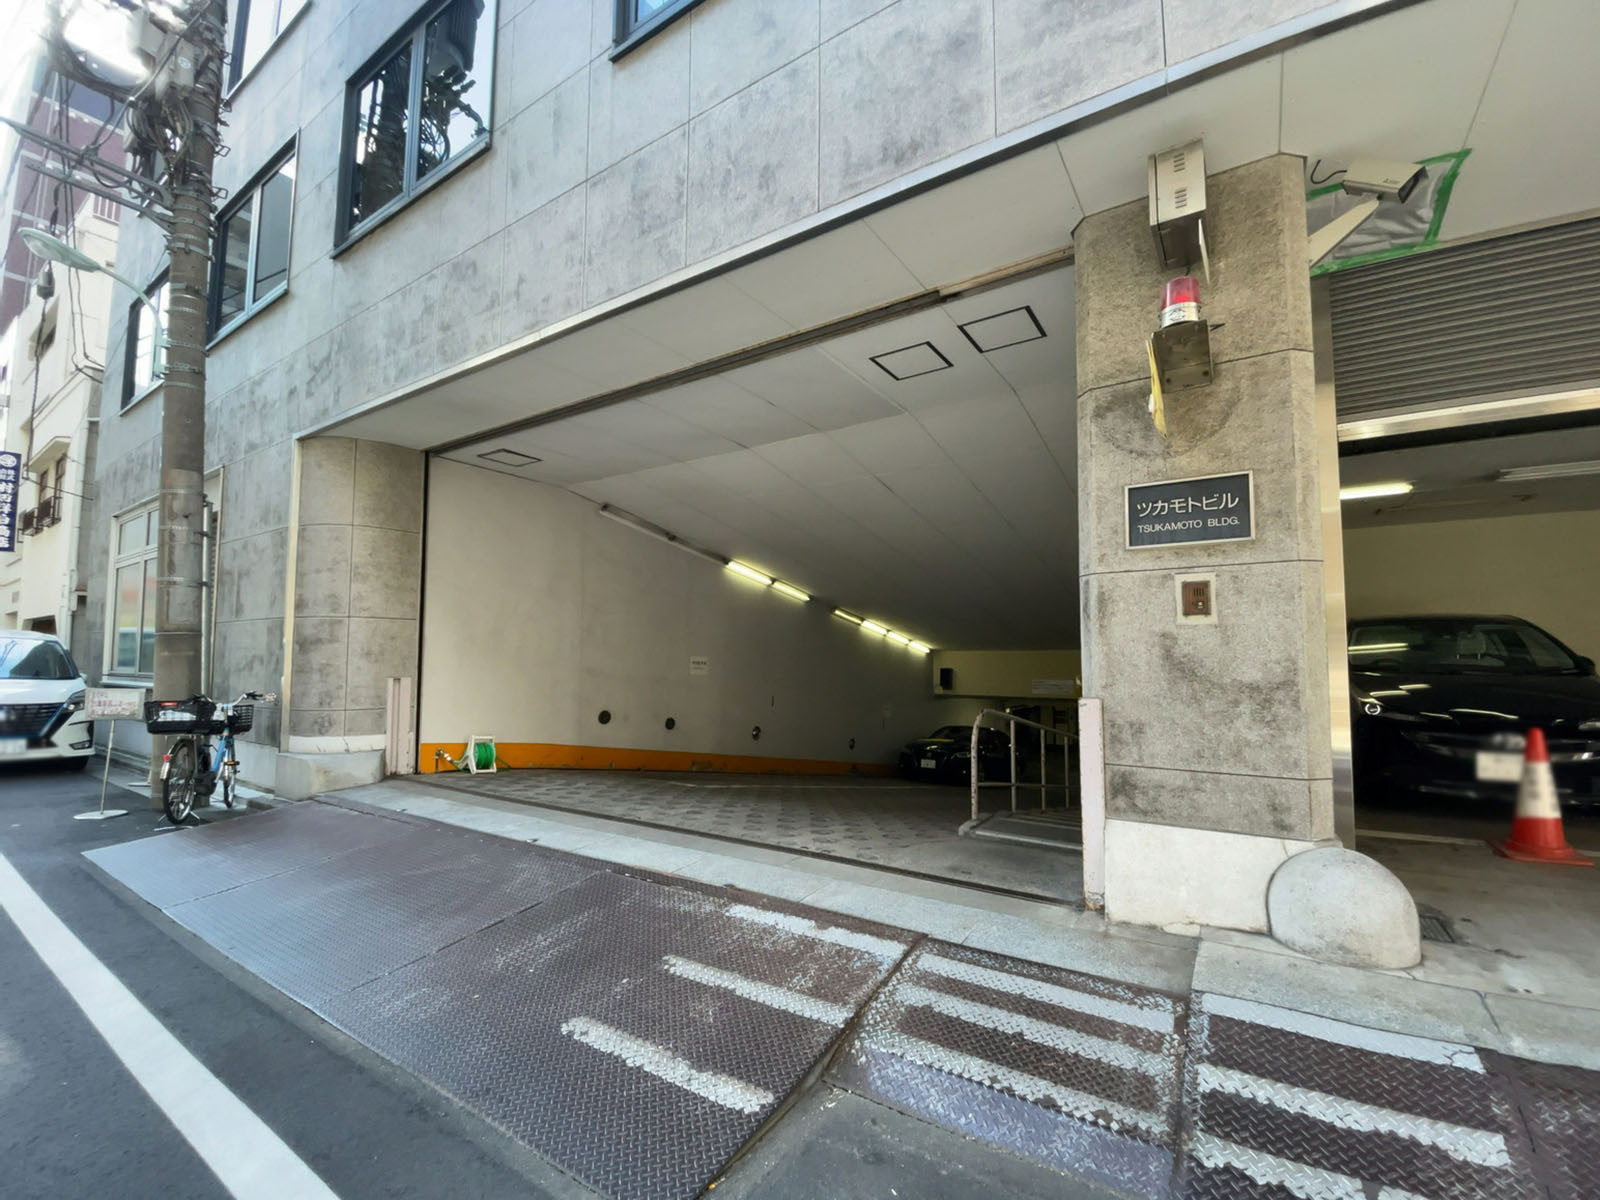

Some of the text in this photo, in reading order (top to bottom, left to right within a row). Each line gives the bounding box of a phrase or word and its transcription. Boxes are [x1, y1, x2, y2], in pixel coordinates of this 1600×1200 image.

[1137, 492, 1239, 518] ツカモトビル
[1138, 516, 1240, 533] TSUKAMOTO BLDG.
